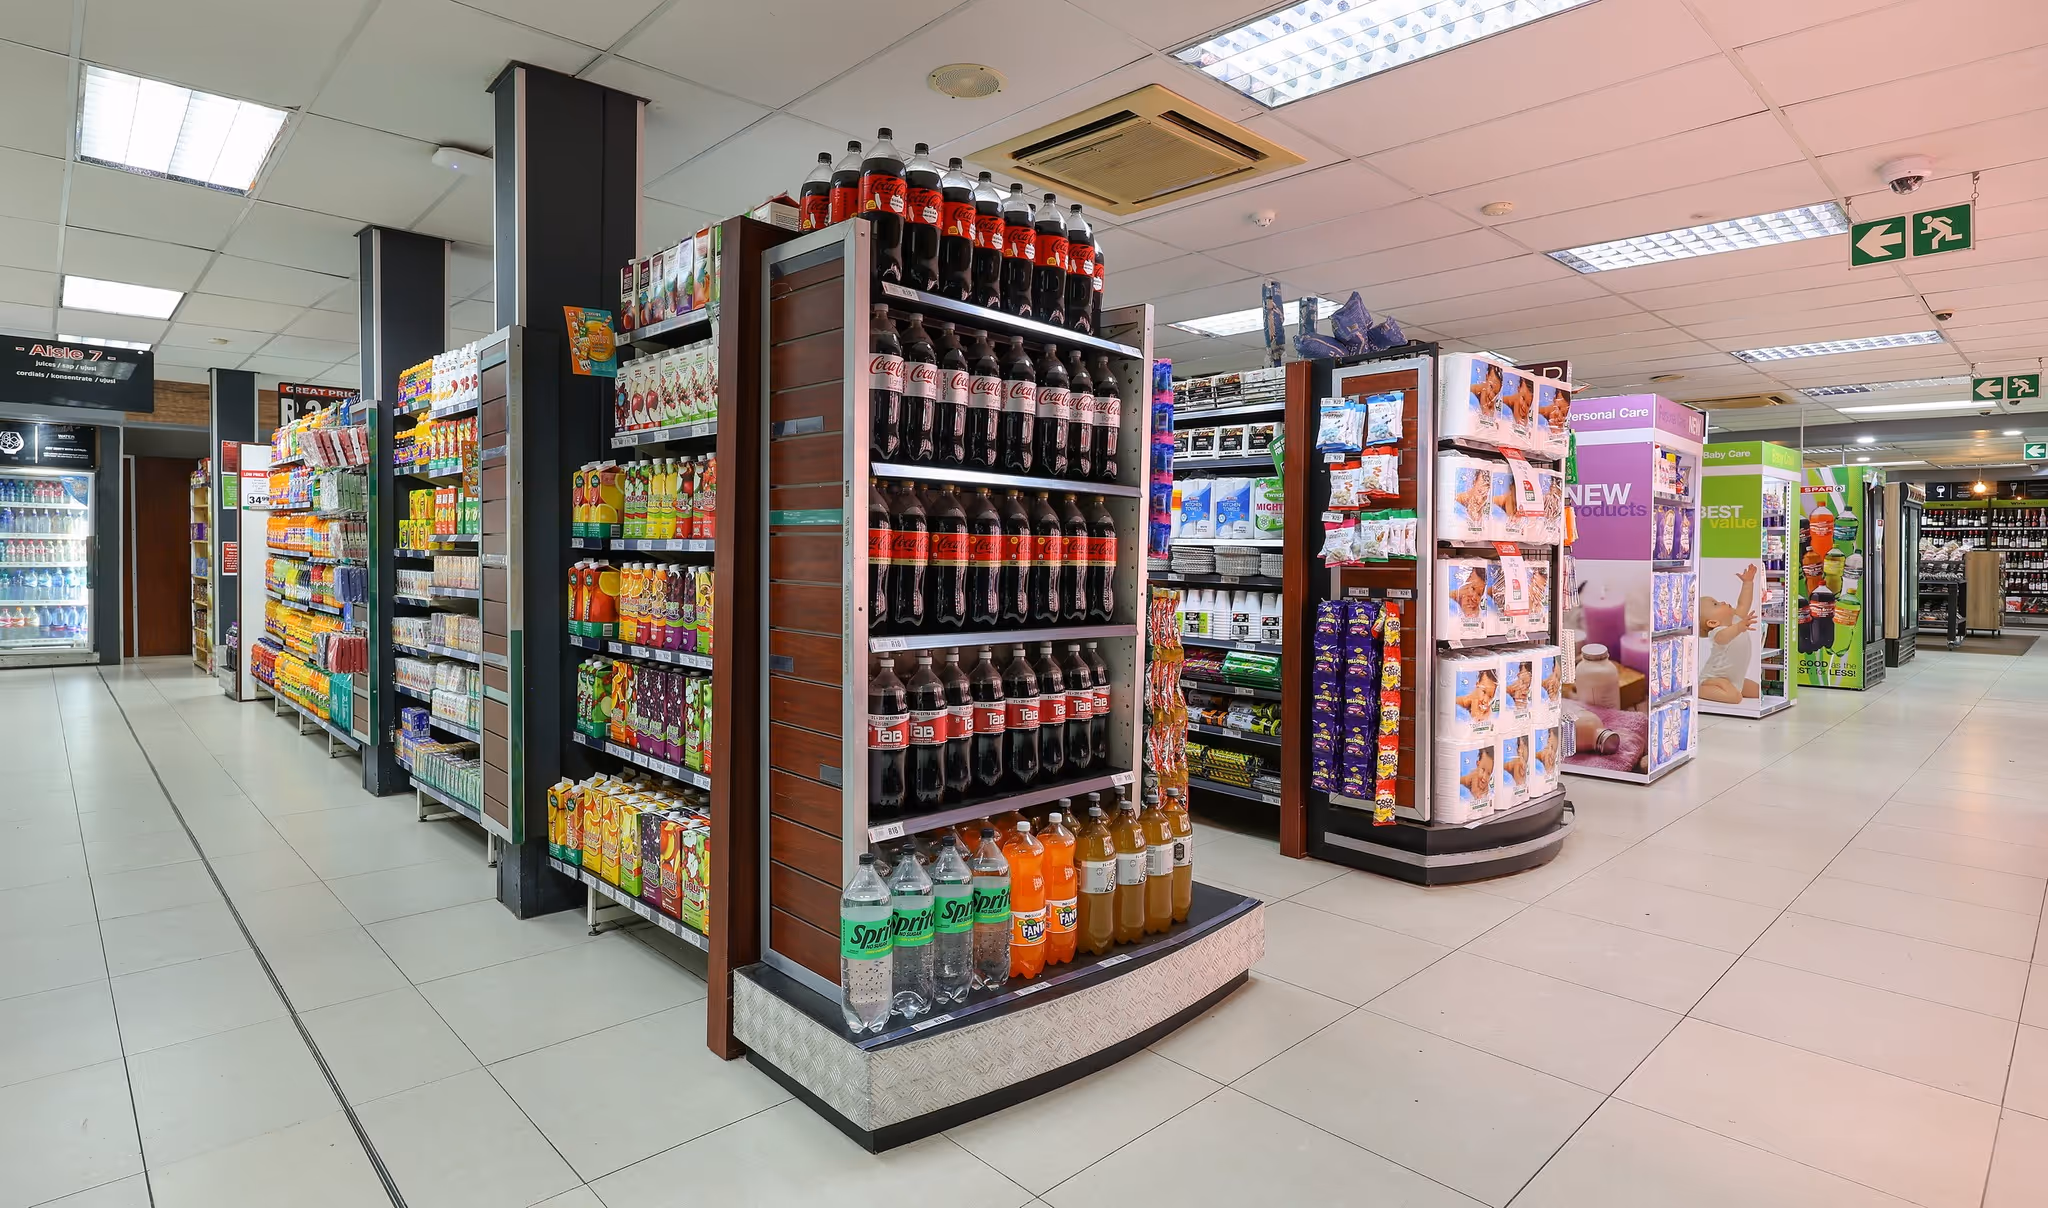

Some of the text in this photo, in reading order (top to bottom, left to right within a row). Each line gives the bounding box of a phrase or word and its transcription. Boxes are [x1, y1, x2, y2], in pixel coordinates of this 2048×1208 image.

[29, 344, 84, 360] Aisle
[88, 350, 102, 362] 7
[51, 373, 92, 382] konsentrate
[286, 387, 326, 396] GREAT
[1568, 409, 1615, 422] ersonal
[1619, 407, 1649, 420] Care
[1703, 450, 1750, 459] Baby Care
[1565, 483, 1632, 505] NEW
[1574, 501, 1647, 516] roducts
[1710, 516, 1757, 529] value
[1829, 669, 1856, 677] LESS!
[962, 717, 973, 730] Ta
[888, 825, 899, 835] R18
